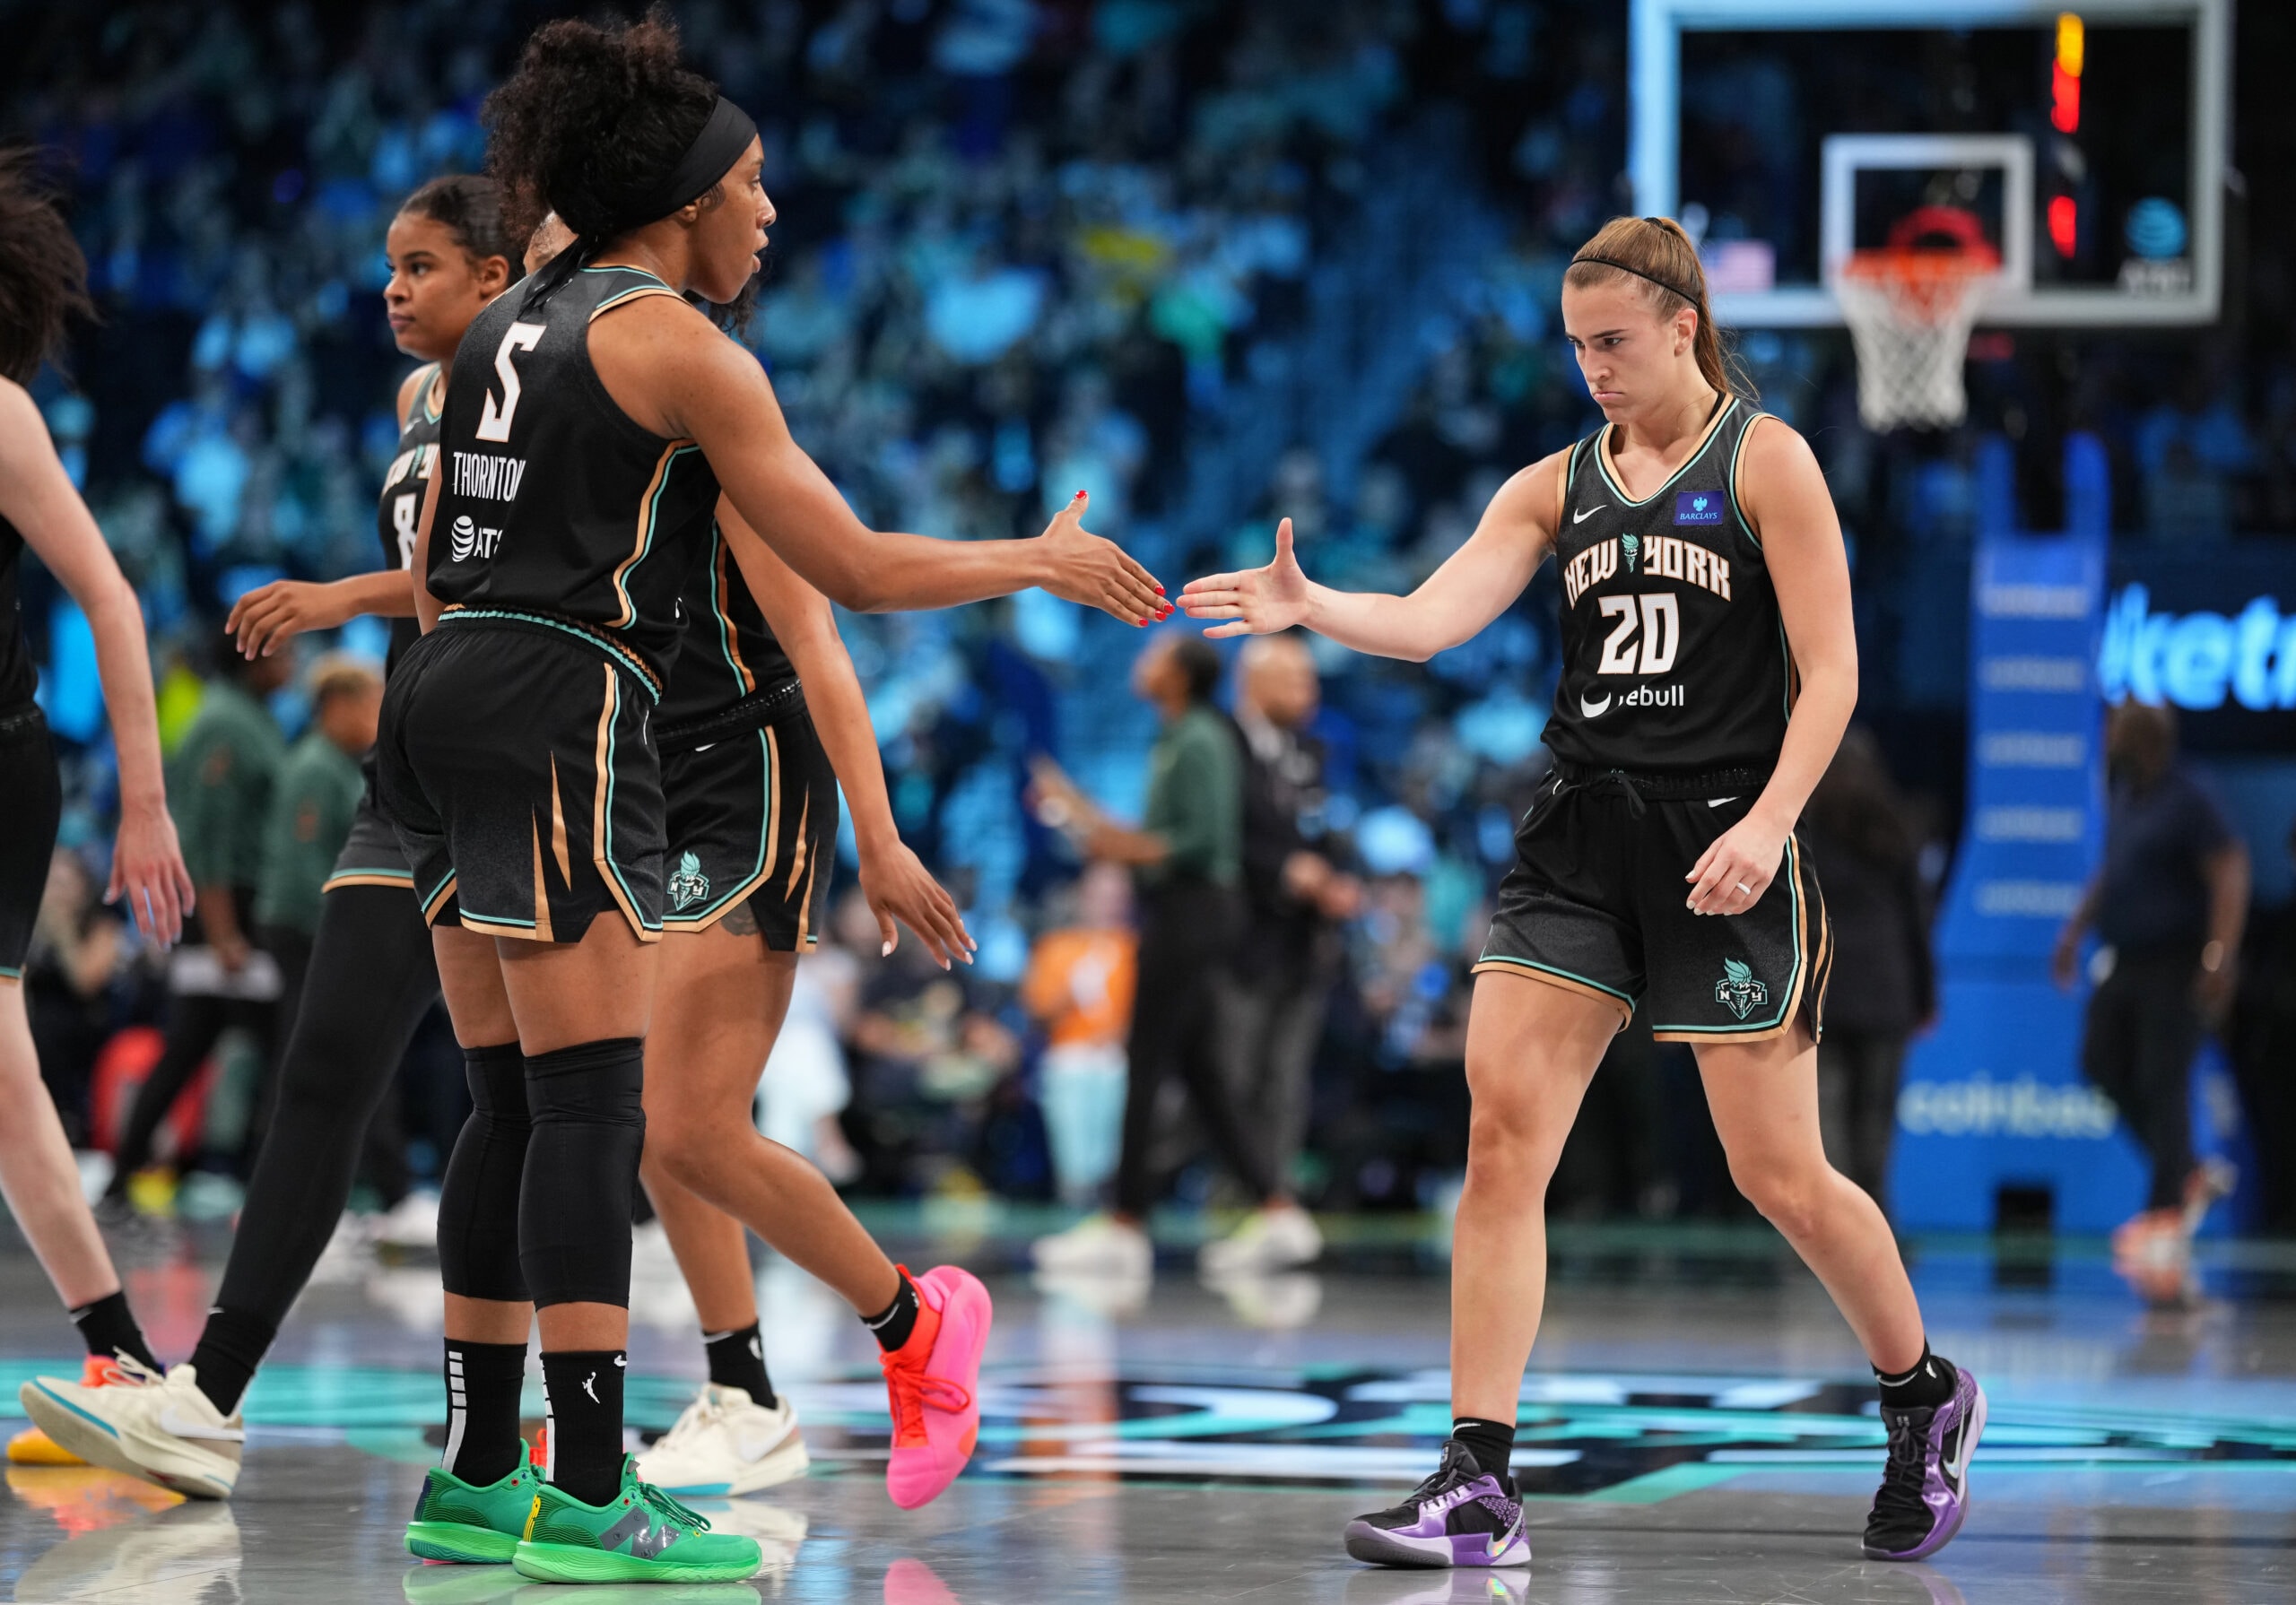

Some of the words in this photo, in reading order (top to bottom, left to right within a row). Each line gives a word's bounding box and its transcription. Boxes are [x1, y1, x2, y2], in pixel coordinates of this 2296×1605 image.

[475, 322, 546, 443] 5
[1680, 512, 1718, 520] BARCLAYS
[1564, 537, 1618, 611] NEW
[1642, 535, 1731, 603] YORK
[1596, 592, 1680, 675] 20
[1617, 684, 1684, 707] ebull
